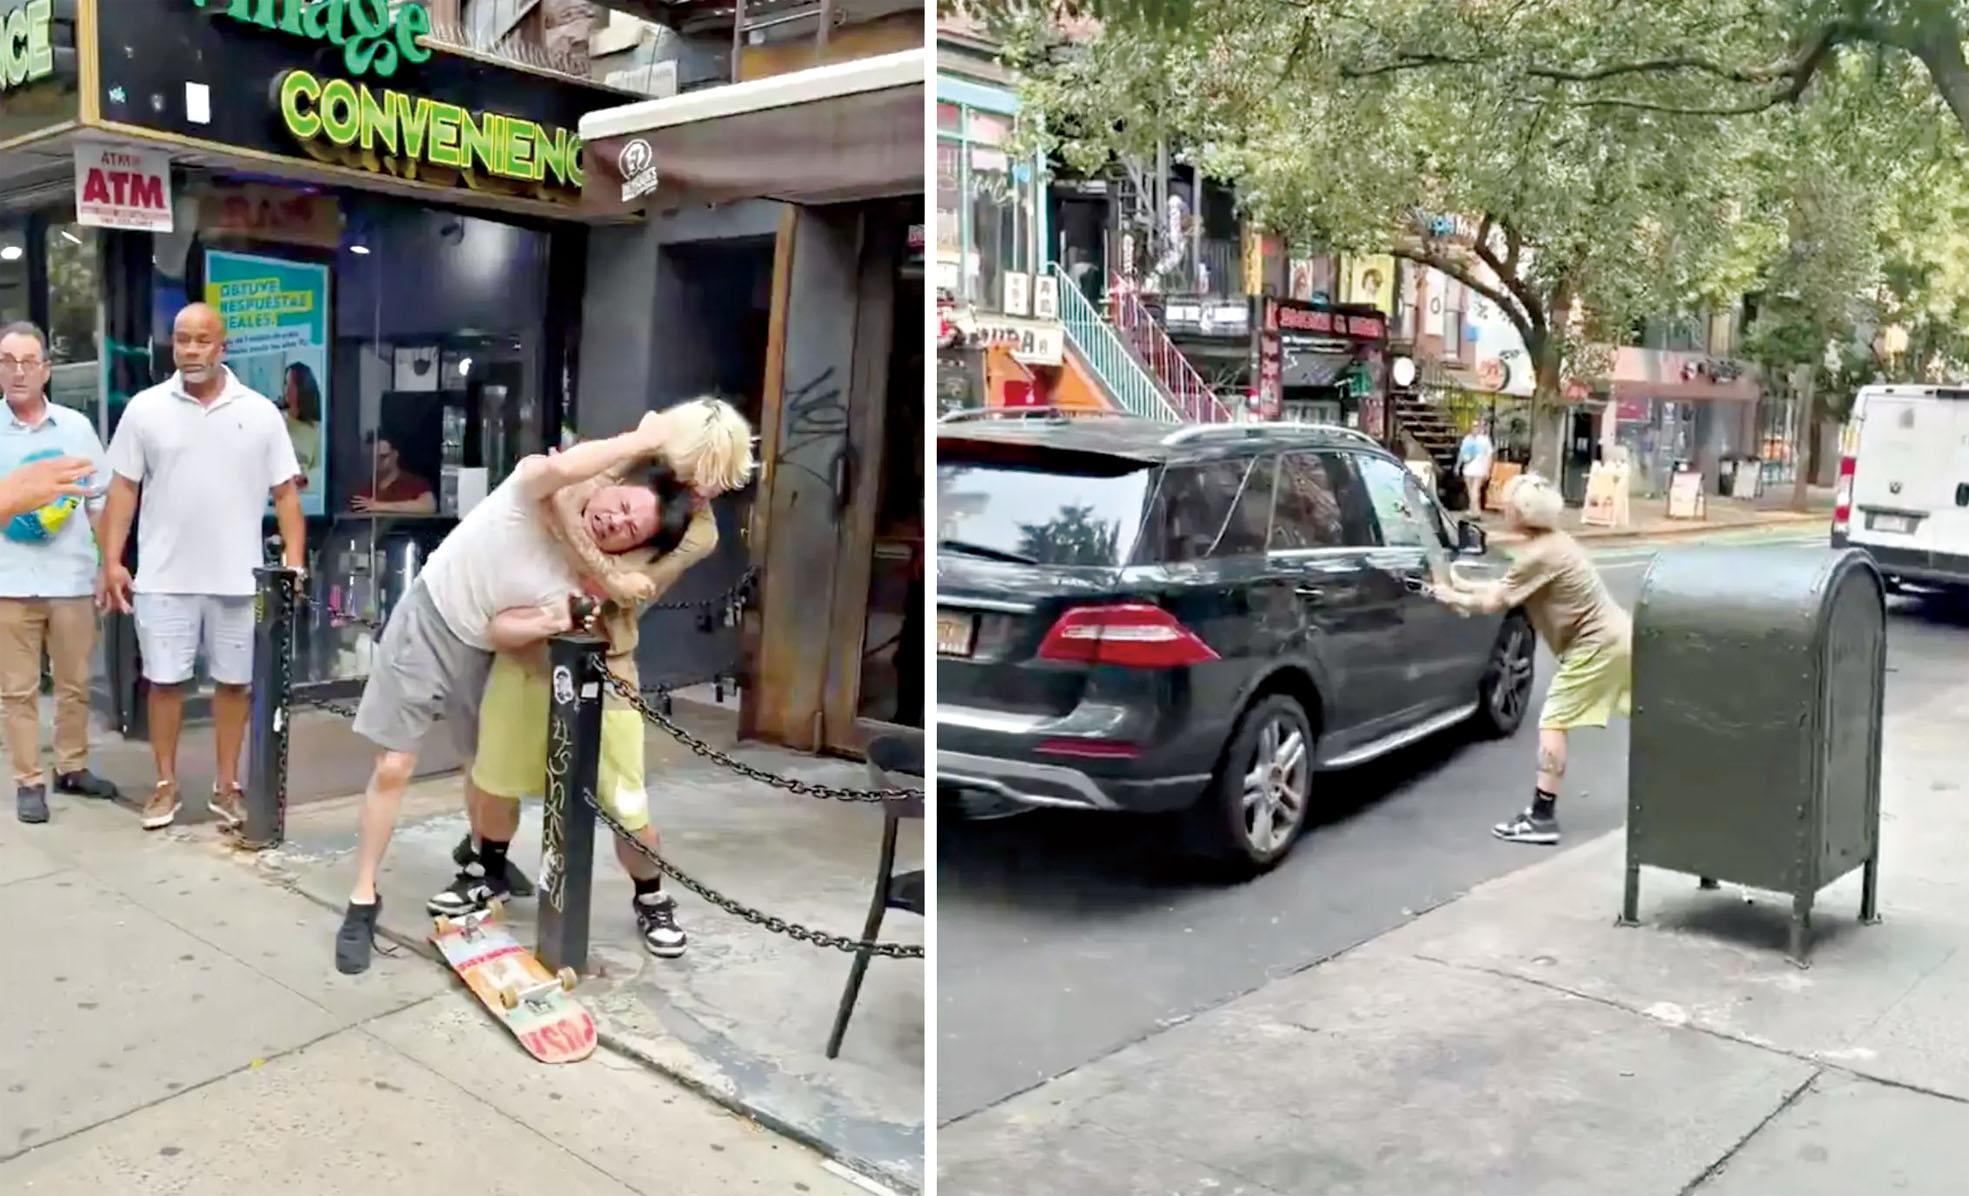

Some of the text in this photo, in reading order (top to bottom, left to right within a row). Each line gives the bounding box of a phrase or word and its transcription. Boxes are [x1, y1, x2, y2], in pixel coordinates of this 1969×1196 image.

[0, 0, 53, 91] CE
[83, 167, 166, 209] ATM
[226, 314, 276, 329] EALES.
